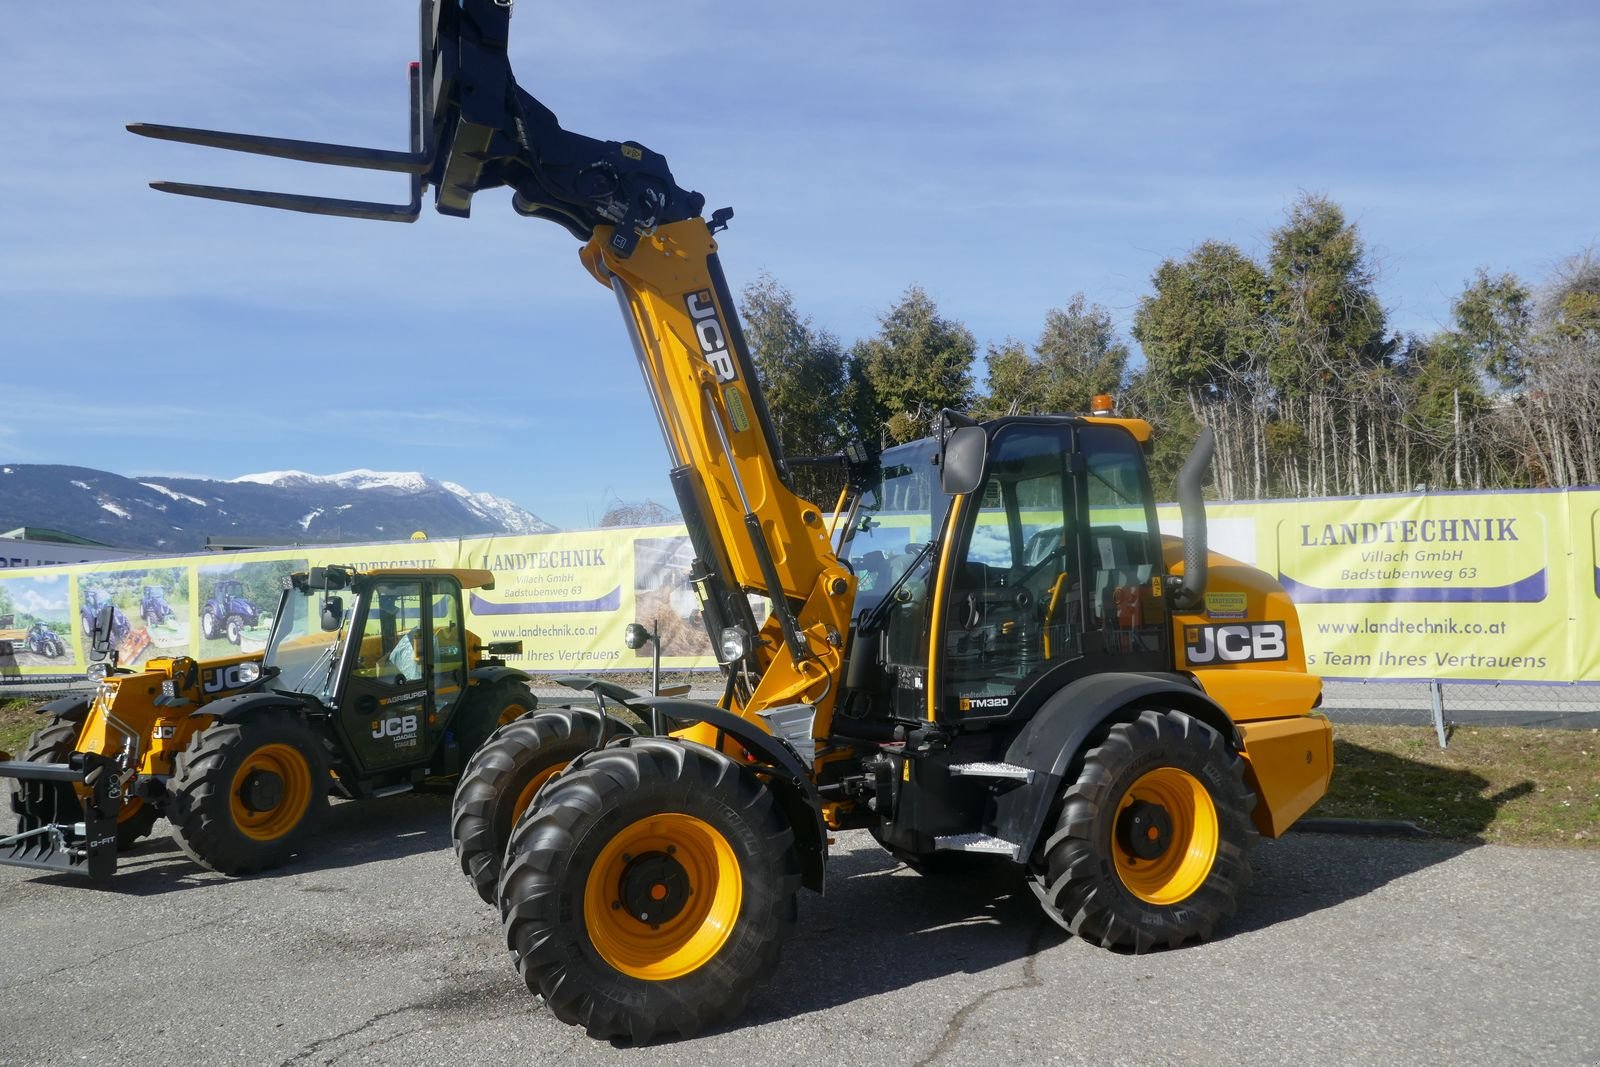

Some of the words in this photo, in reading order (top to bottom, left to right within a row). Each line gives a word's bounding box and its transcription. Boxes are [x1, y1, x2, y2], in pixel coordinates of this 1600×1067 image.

[687, 294, 735, 383] JCB
[1301, 518, 1519, 547] LANDTECHNIK
[483, 549, 606, 571] LANDTECHNIK
[1361, 550, 1409, 563] Villach
[1415, 550, 1464, 562] GmbH
[516, 574, 544, 585] Villach
[546, 573, 574, 584] GmbH
[1340, 569, 1453, 582] Badstubenweg
[1458, 567, 1478, 579] 63
[504, 587, 568, 599] Badstubenweg
[571, 586, 583, 596] 63
[491, 625, 598, 639] www.landtechnik.co.at
[1318, 617, 1507, 635] www.landtechnik.co.at
[1187, 624, 1286, 663] JCB
[527, 650, 554, 661] Ihres
[558, 650, 620, 662] Vertrauens
[1323, 651, 1371, 666] Team
[1378, 652, 1427, 667] Ihres
[1435, 652, 1547, 669] Vertrauens
[204, 666, 241, 692] JC
[970, 698, 1008, 708] TM320
[153, 727, 176, 739] JC
[372, 715, 418, 739] JCB
